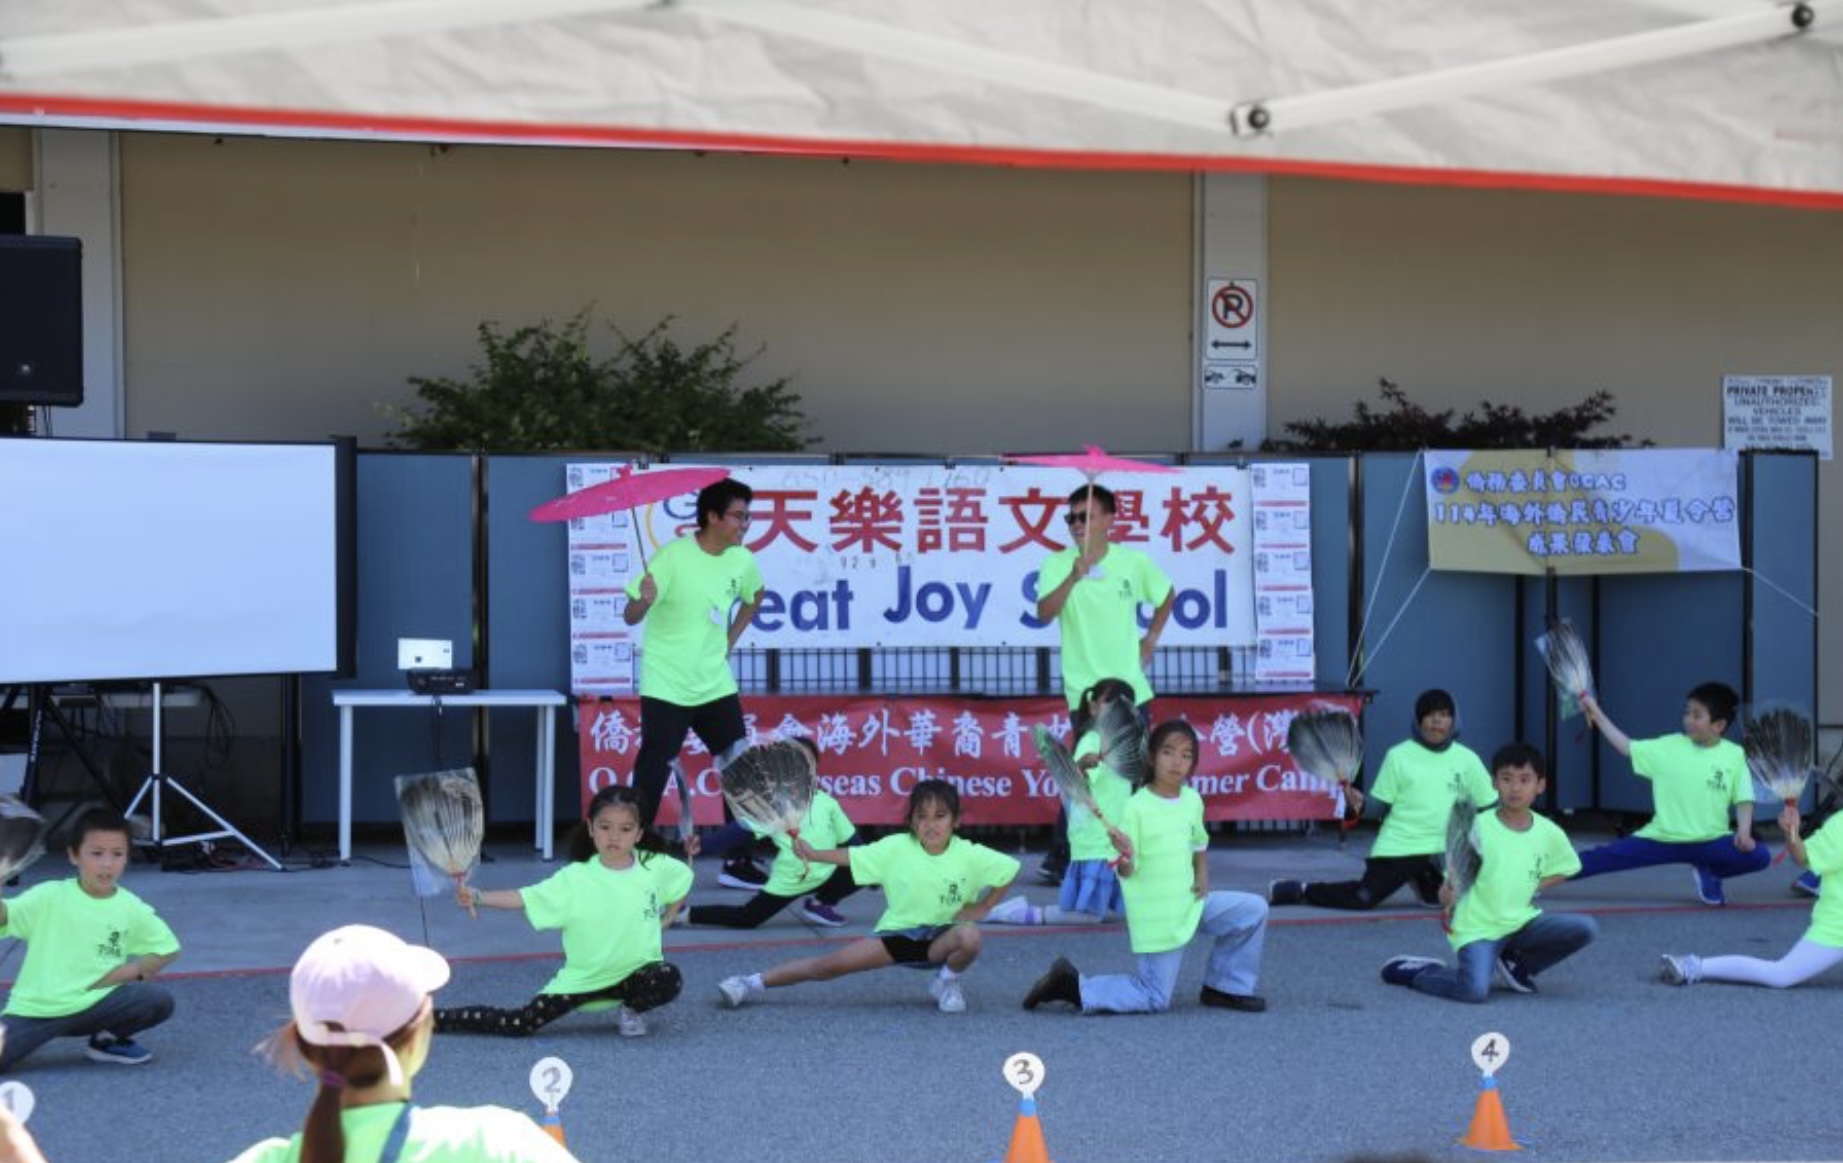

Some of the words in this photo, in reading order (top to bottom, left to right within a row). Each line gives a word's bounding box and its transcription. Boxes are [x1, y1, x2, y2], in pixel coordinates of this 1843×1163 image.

[1773, 386, 1823, 396] PROPER
[727, 579, 854, 632] eat
[883, 565, 993, 630] Joy
[1019, 568, 1228, 630] Sol
[817, 773, 882, 796] seas
[1191, 772, 1251, 796] mer
[1481, 1038, 1500, 1063] 4
[541, 1066, 563, 1094] 2
[1012, 1059, 1035, 1086] 3
